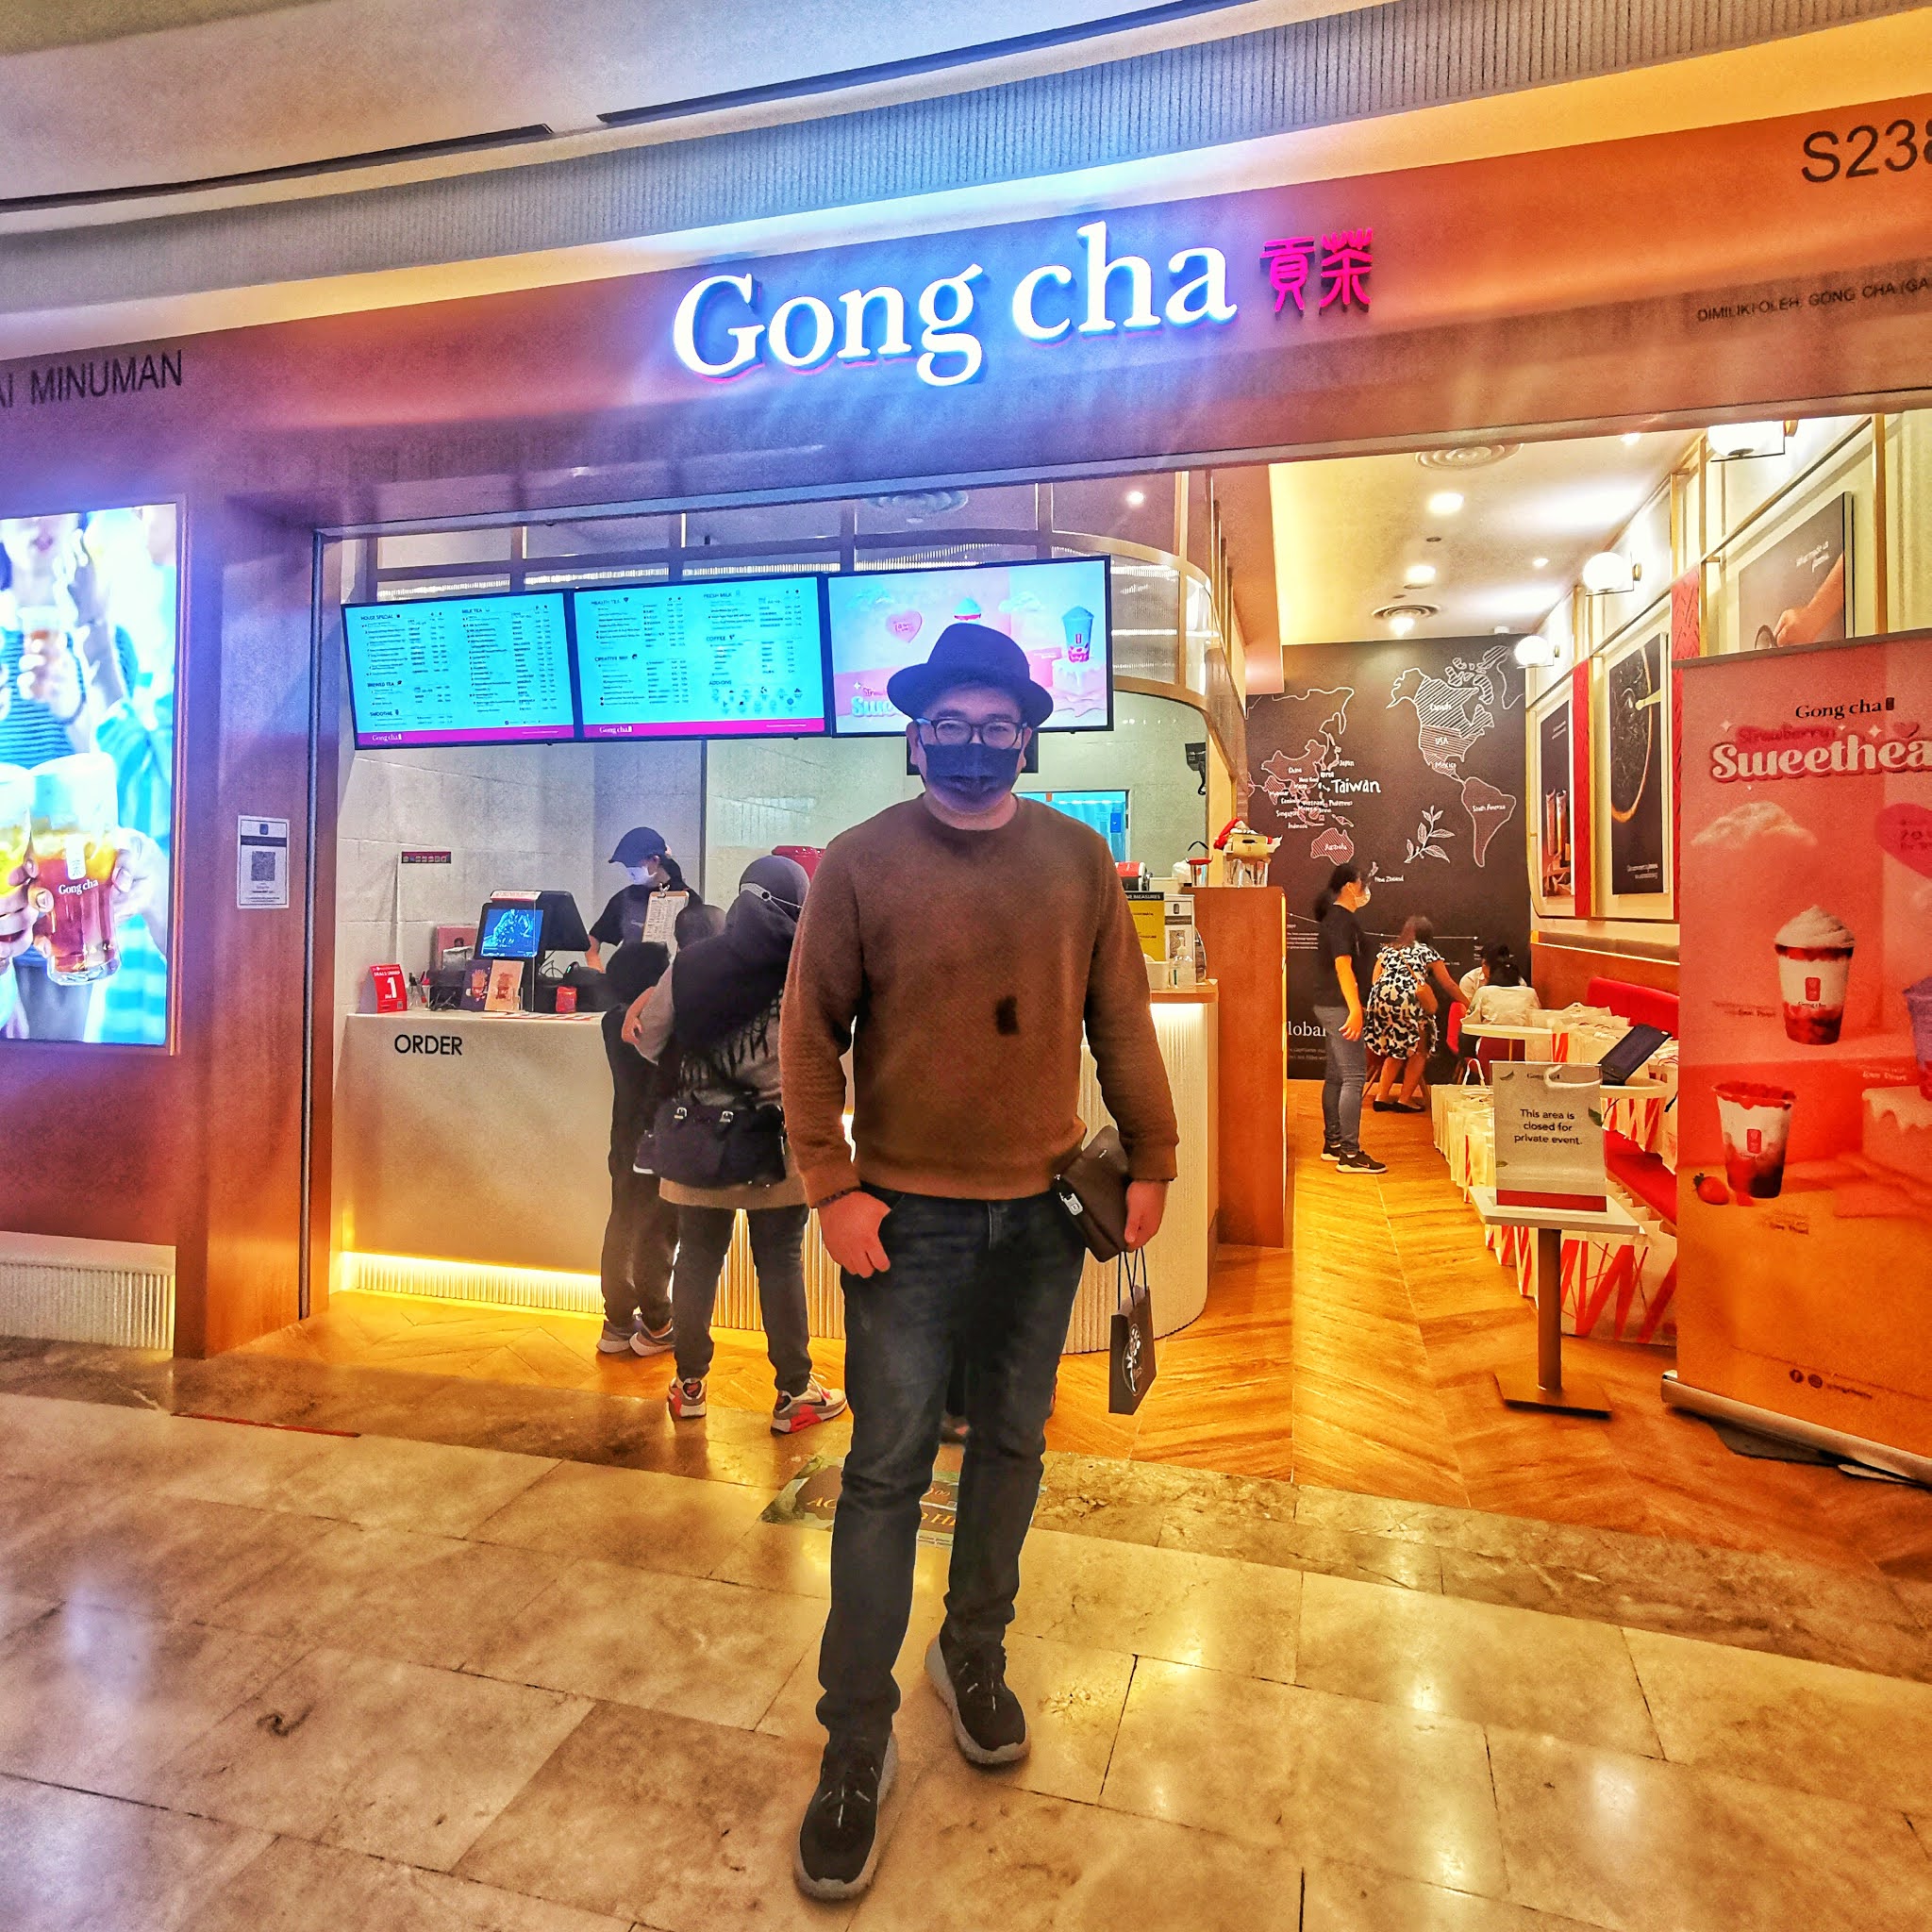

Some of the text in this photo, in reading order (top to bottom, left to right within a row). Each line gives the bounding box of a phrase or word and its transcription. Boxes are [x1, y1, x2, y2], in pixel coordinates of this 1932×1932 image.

[1802, 119, 1932, 183] S23
[1259, 227, 1374, 312] 貢茶
[673, 221, 1237, 388] Gong cha
[1697, 302, 1755, 322] DIMILIKI
[1759, 298, 1800, 313] OLEH
[1808, 288, 1856, 307] GONG
[1862, 282, 1895, 298] CHA
[31, 349, 182, 405] MINUMAN
[1795, 698, 1882, 720] Gong cha
[599, 724, 628, 734] Gong cha
[1434, 760, 1457, 769] Mexico
[1331, 778, 1382, 793] Taiwan
[58, 878, 99, 895] Gong cha
[394, 1034, 463, 1056] ORDER
[1520, 1108, 1540, 1118] This
[1567, 1111, 1575, 1120] is
[1524, 1121, 1573, 1131] closed for
[1514, 1134, 1583, 1145] private event.
